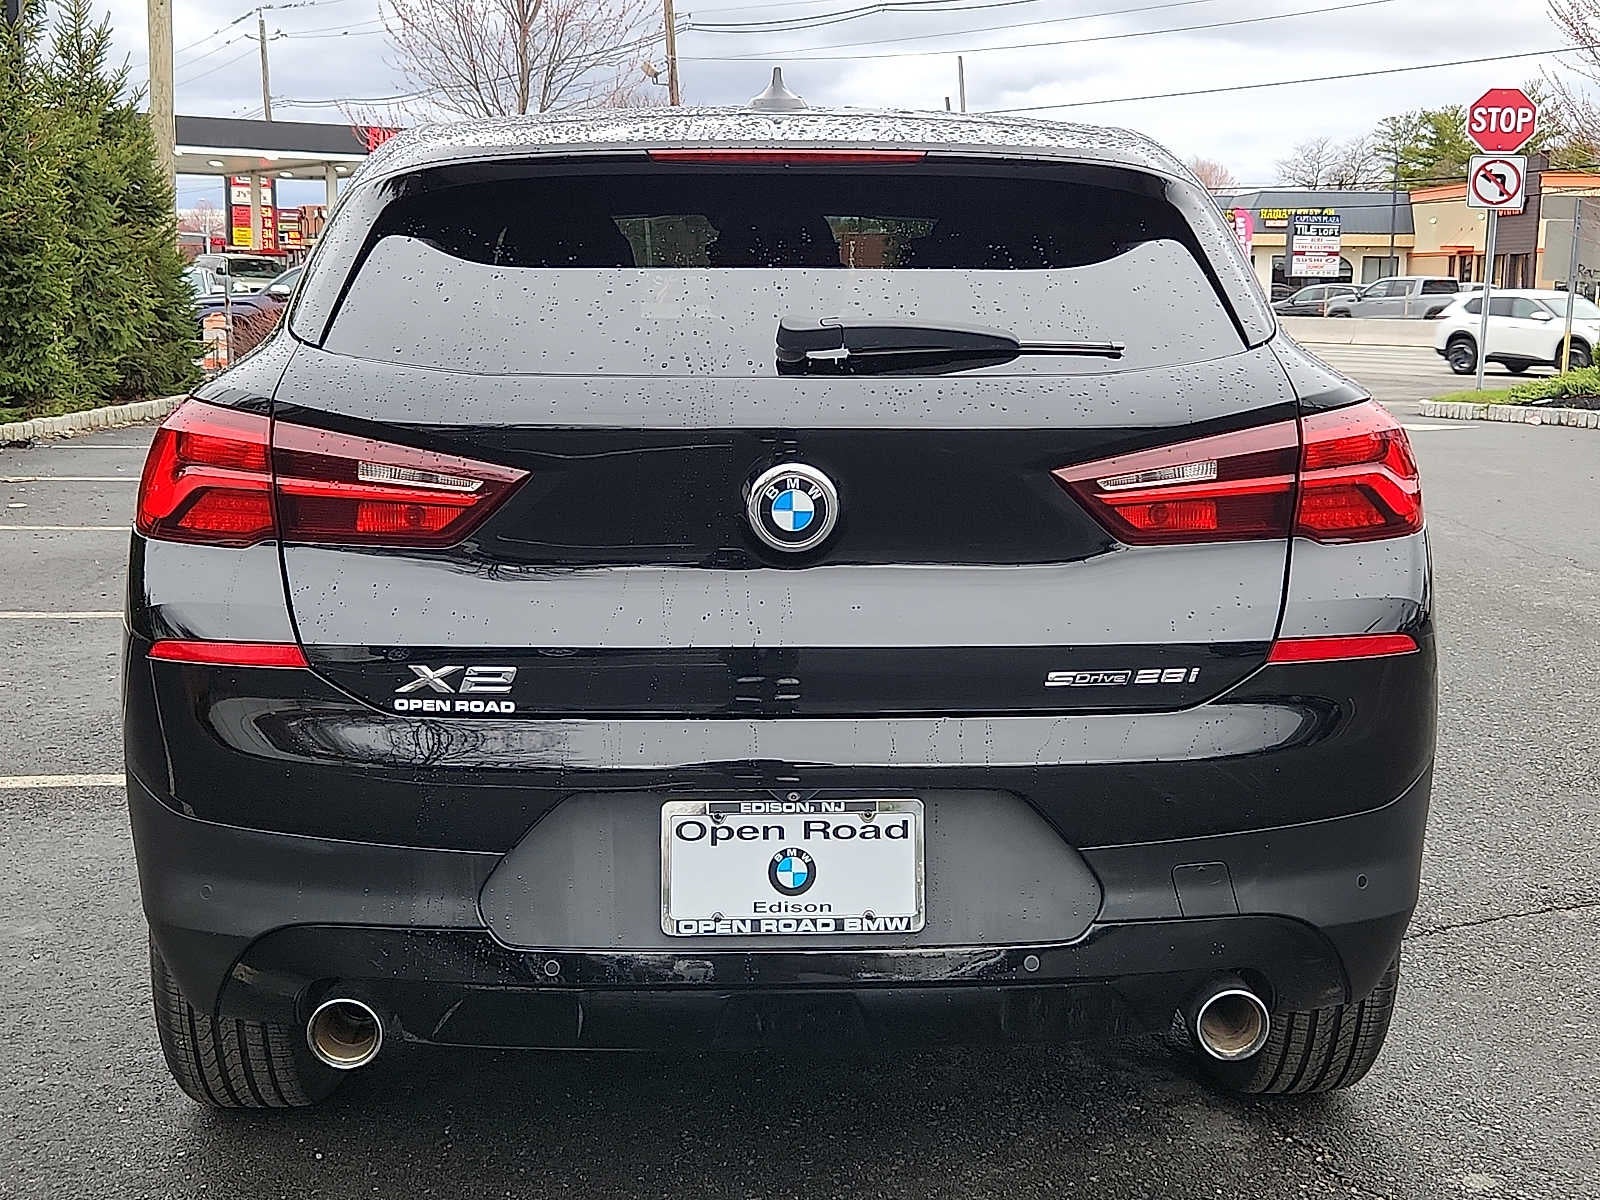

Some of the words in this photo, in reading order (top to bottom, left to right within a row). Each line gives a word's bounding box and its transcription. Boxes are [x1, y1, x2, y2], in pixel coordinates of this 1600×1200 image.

[1471, 107, 1533, 133] STOP
[1295, 225, 1317, 236] TILE
[765, 478, 822, 501] BMW
[395, 665, 517, 694] X2
[394, 699, 451, 712] OPEN
[455, 701, 516, 713] ROAD
[740, 802, 815, 813] EDISON,
[821, 802, 846, 812] NJ
[675, 820, 786, 846] Open
[803, 819, 910, 840] Road
[773, 848, 812, 864] BMW
[753, 901, 833, 914] Edison
[678, 920, 752, 934] OPEN
[760, 918, 836, 933] ROAD
[844, 917, 910, 932] BMW
